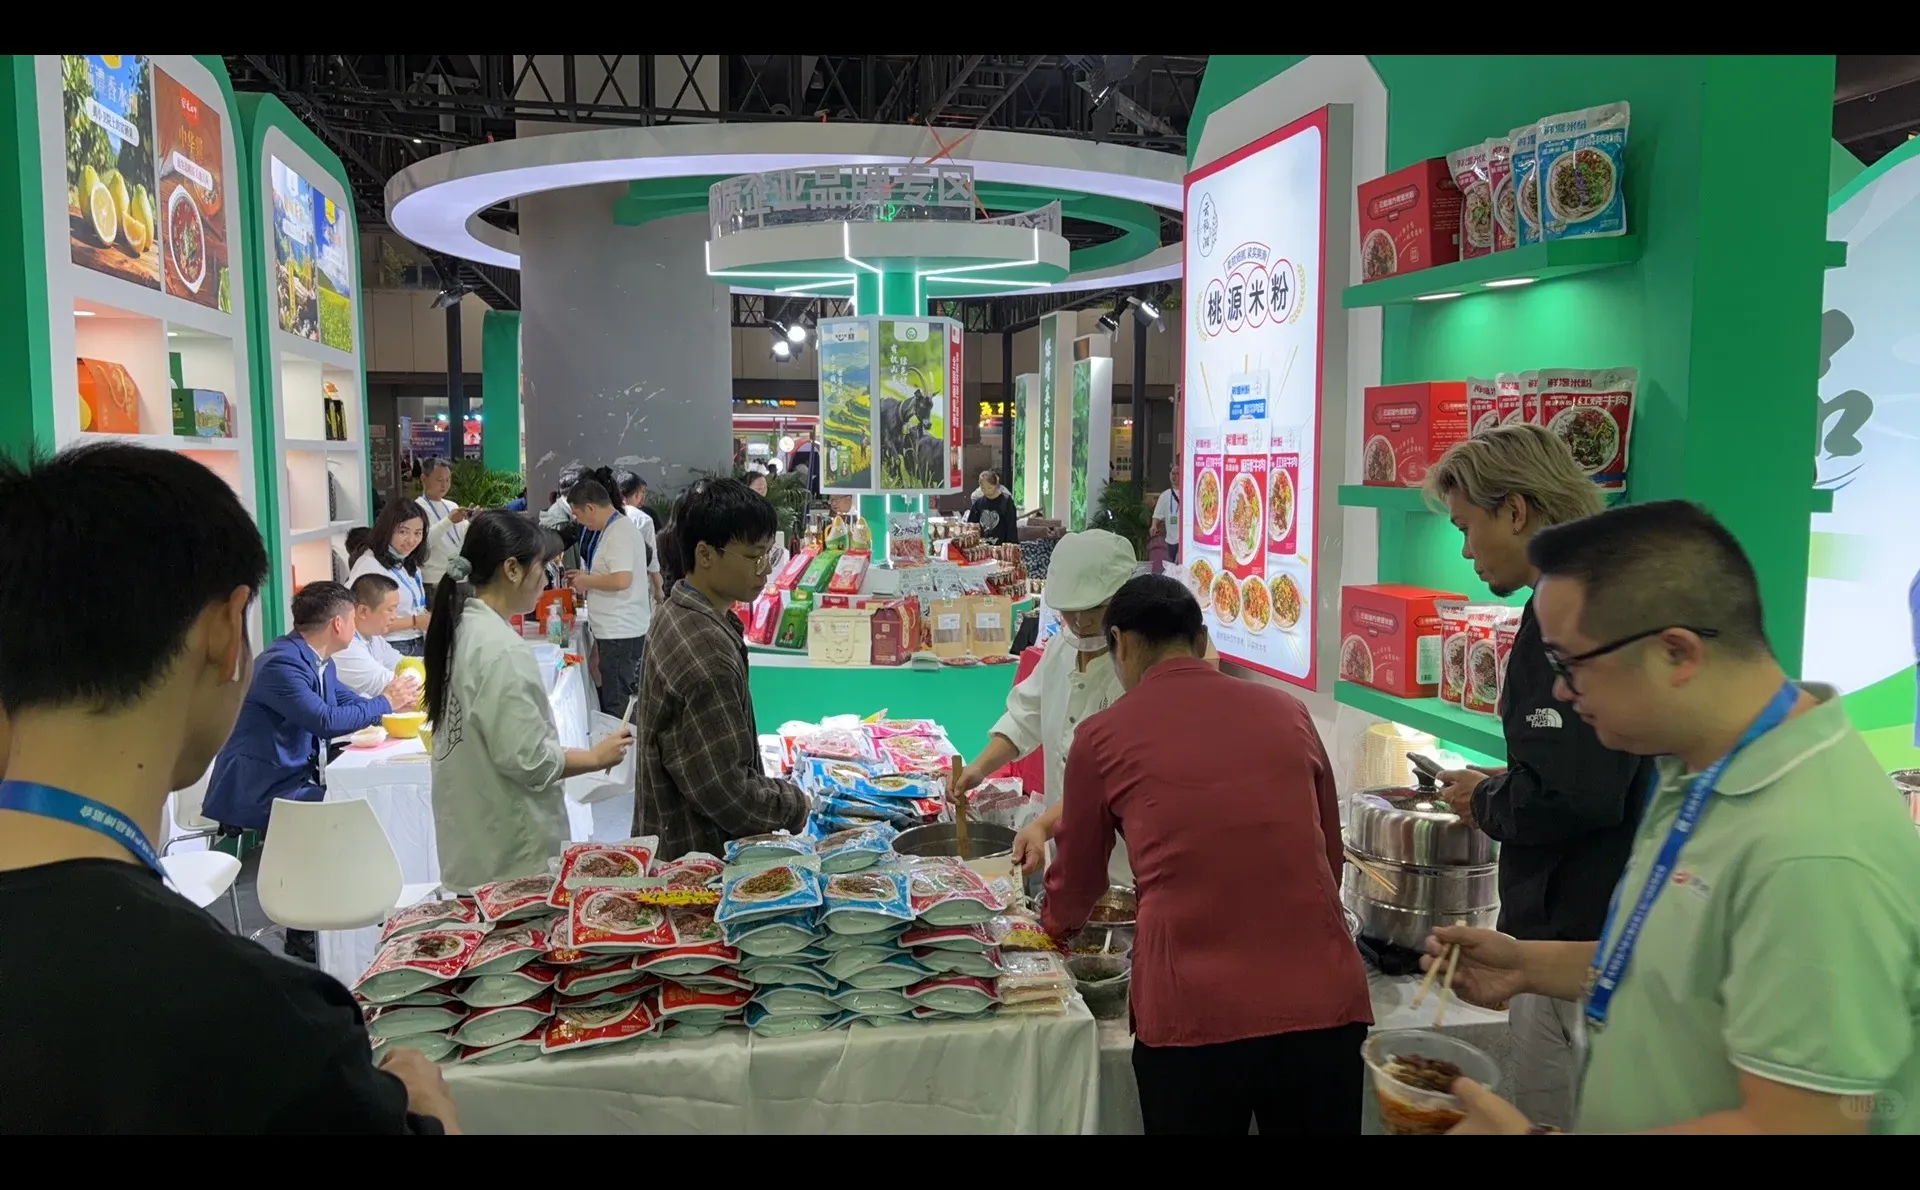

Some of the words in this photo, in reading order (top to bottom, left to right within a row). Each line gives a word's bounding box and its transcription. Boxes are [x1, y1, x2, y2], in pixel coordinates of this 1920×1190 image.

[1207, 271, 1289, 326] 桃源米粉
[1547, 378, 1592, 388] 鲜湿米粉
[1578, 394, 1628, 407] 红烧牛肉
[1525, 714, 1548, 722] NORTH
[1531, 720, 1548, 728] FACE
